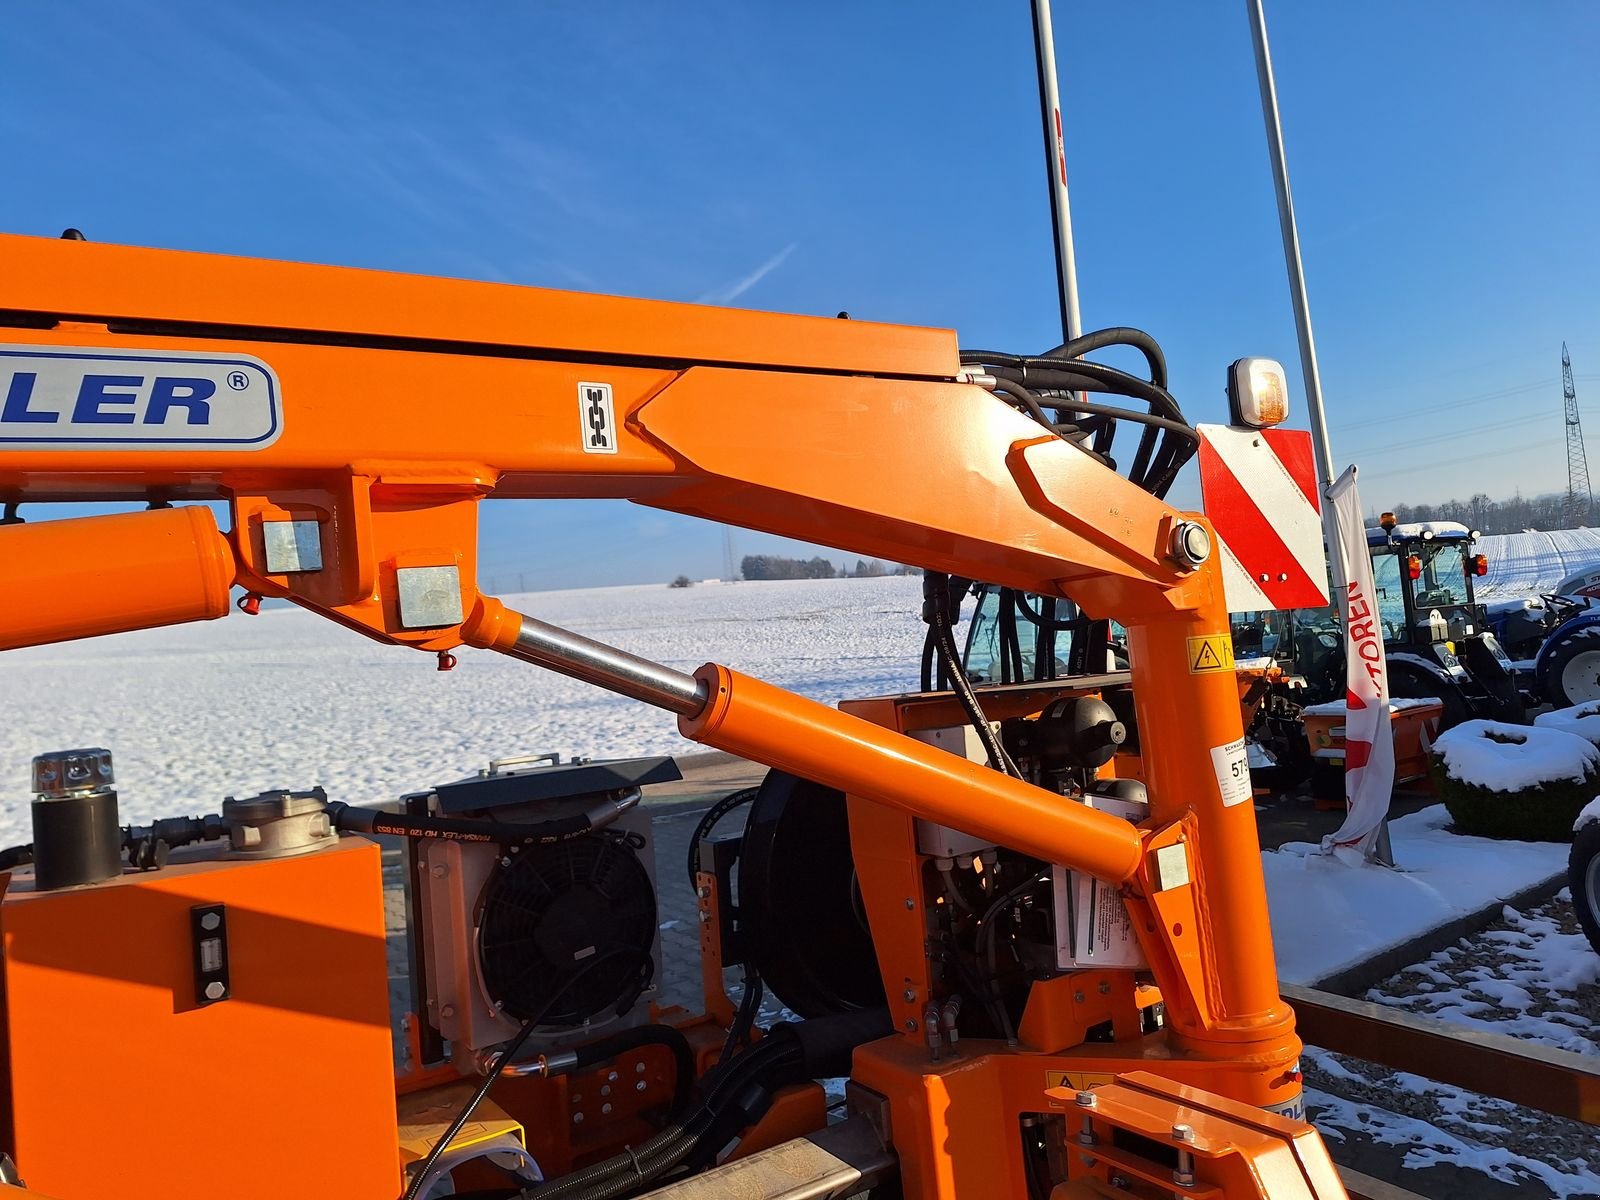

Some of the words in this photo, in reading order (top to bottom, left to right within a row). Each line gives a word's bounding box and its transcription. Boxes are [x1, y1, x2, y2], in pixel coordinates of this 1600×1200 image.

[0, 371, 217, 425] LER
[377, 825, 392, 834] 853
[392, 827, 405, 835] EN
[410, 828, 423, 836] 120
[424, 829, 438, 837] HD
[442, 831, 491, 842] HANSA-FLEX
